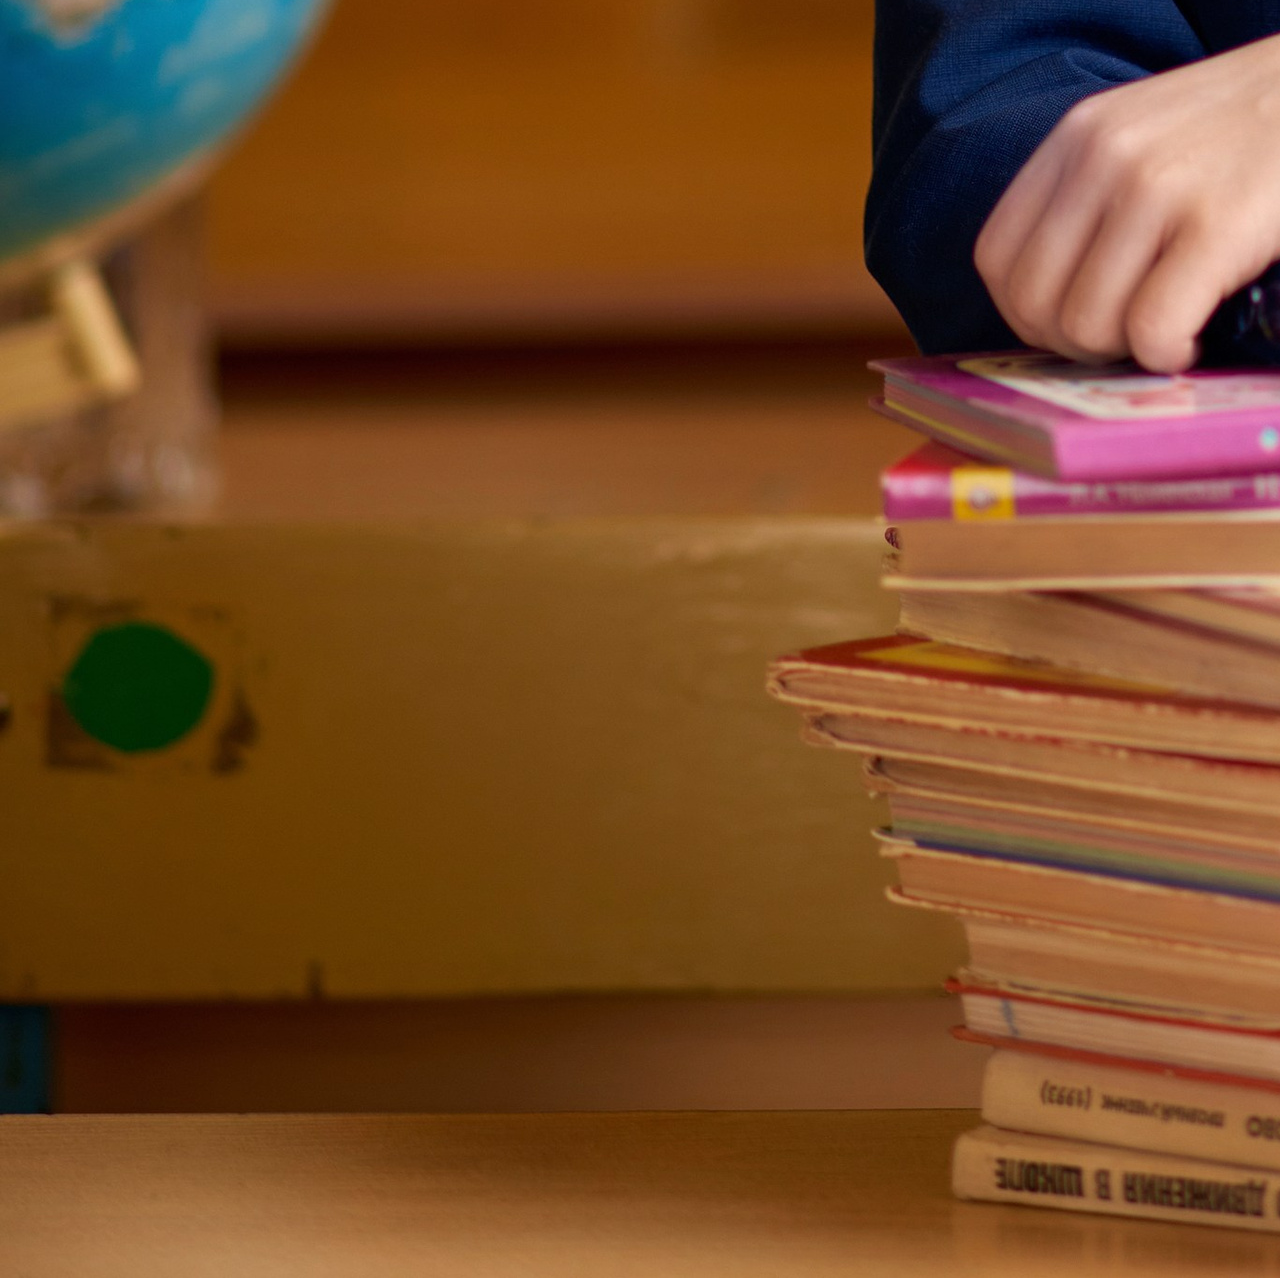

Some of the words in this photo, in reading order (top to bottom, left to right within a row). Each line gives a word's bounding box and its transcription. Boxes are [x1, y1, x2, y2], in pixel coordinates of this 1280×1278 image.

[1040, 1080, 1092, 1111] (1993)
[994, 1157, 1085, 1198] ШКОЛЕ
[1094, 1168, 1113, 1201] В
[1122, 1171, 1268, 1217] ДВИЖЕНИЯ
